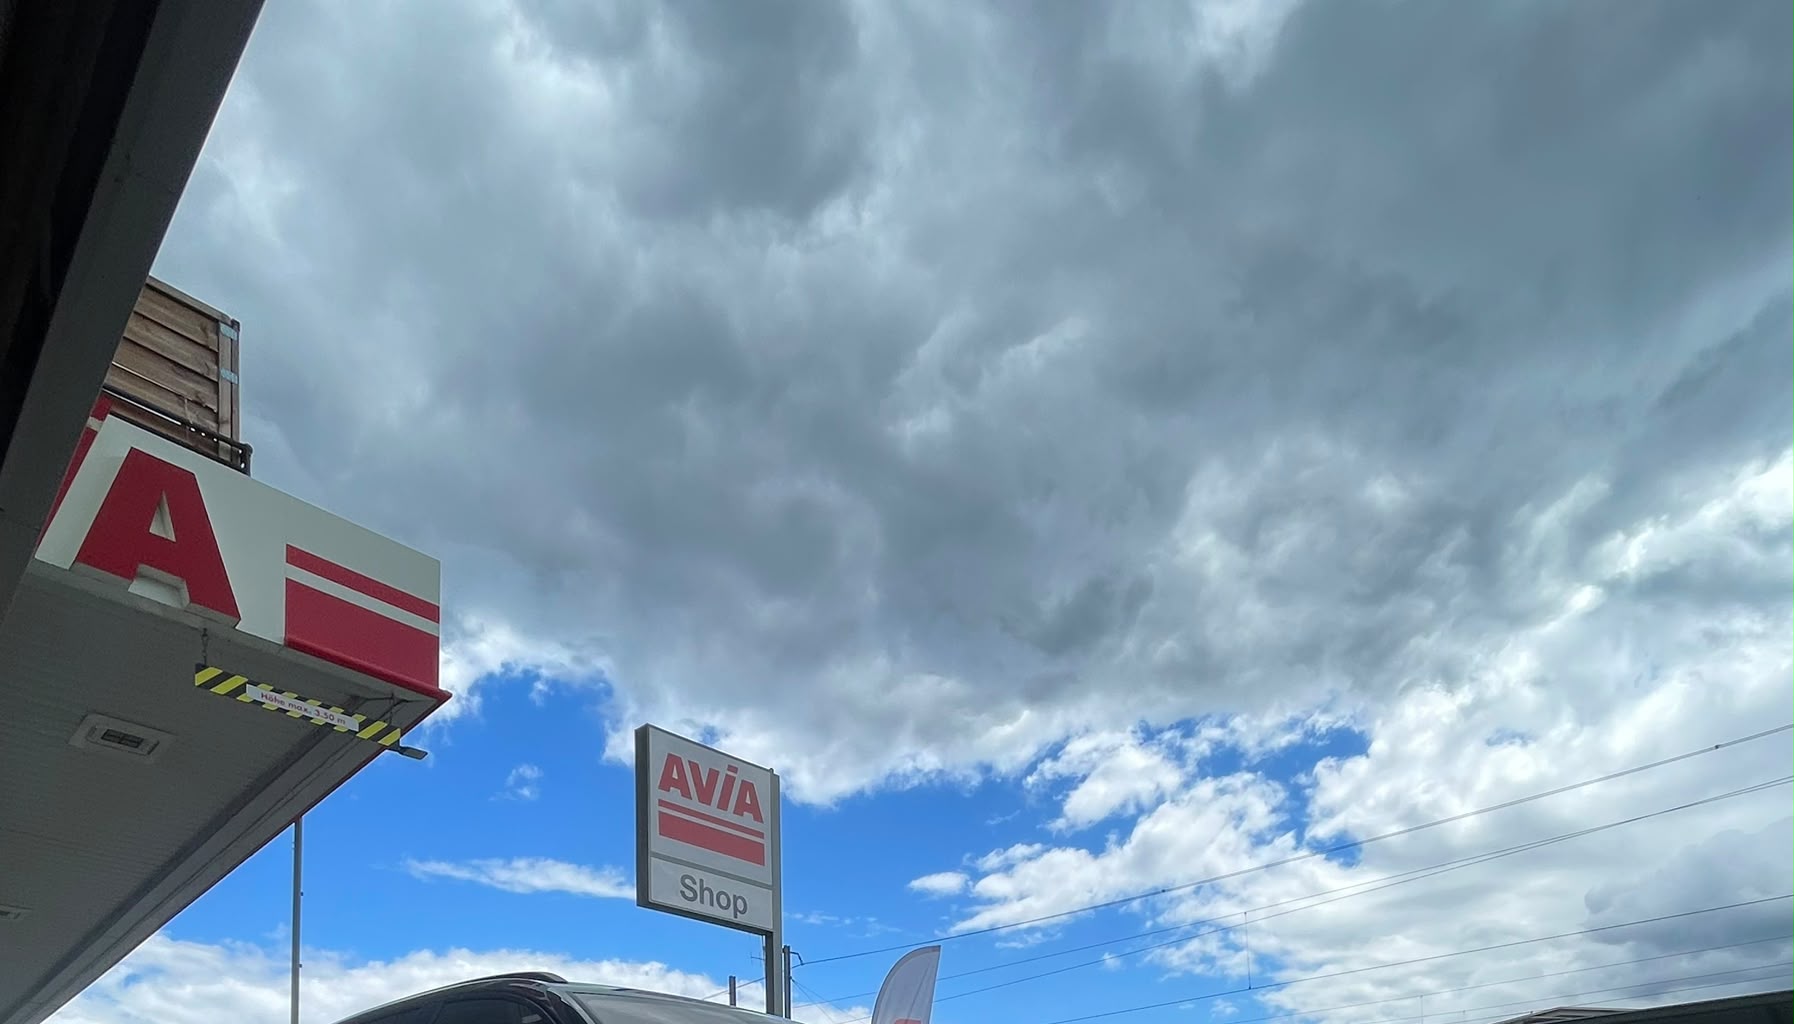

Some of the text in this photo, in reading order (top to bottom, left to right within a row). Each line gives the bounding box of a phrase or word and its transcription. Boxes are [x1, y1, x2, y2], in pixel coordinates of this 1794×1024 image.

[260, 691, 286, 707] Höhe
[337, 717, 346, 726] m
[658, 752, 765, 824] AVIA
[680, 873, 748, 919] Shop
